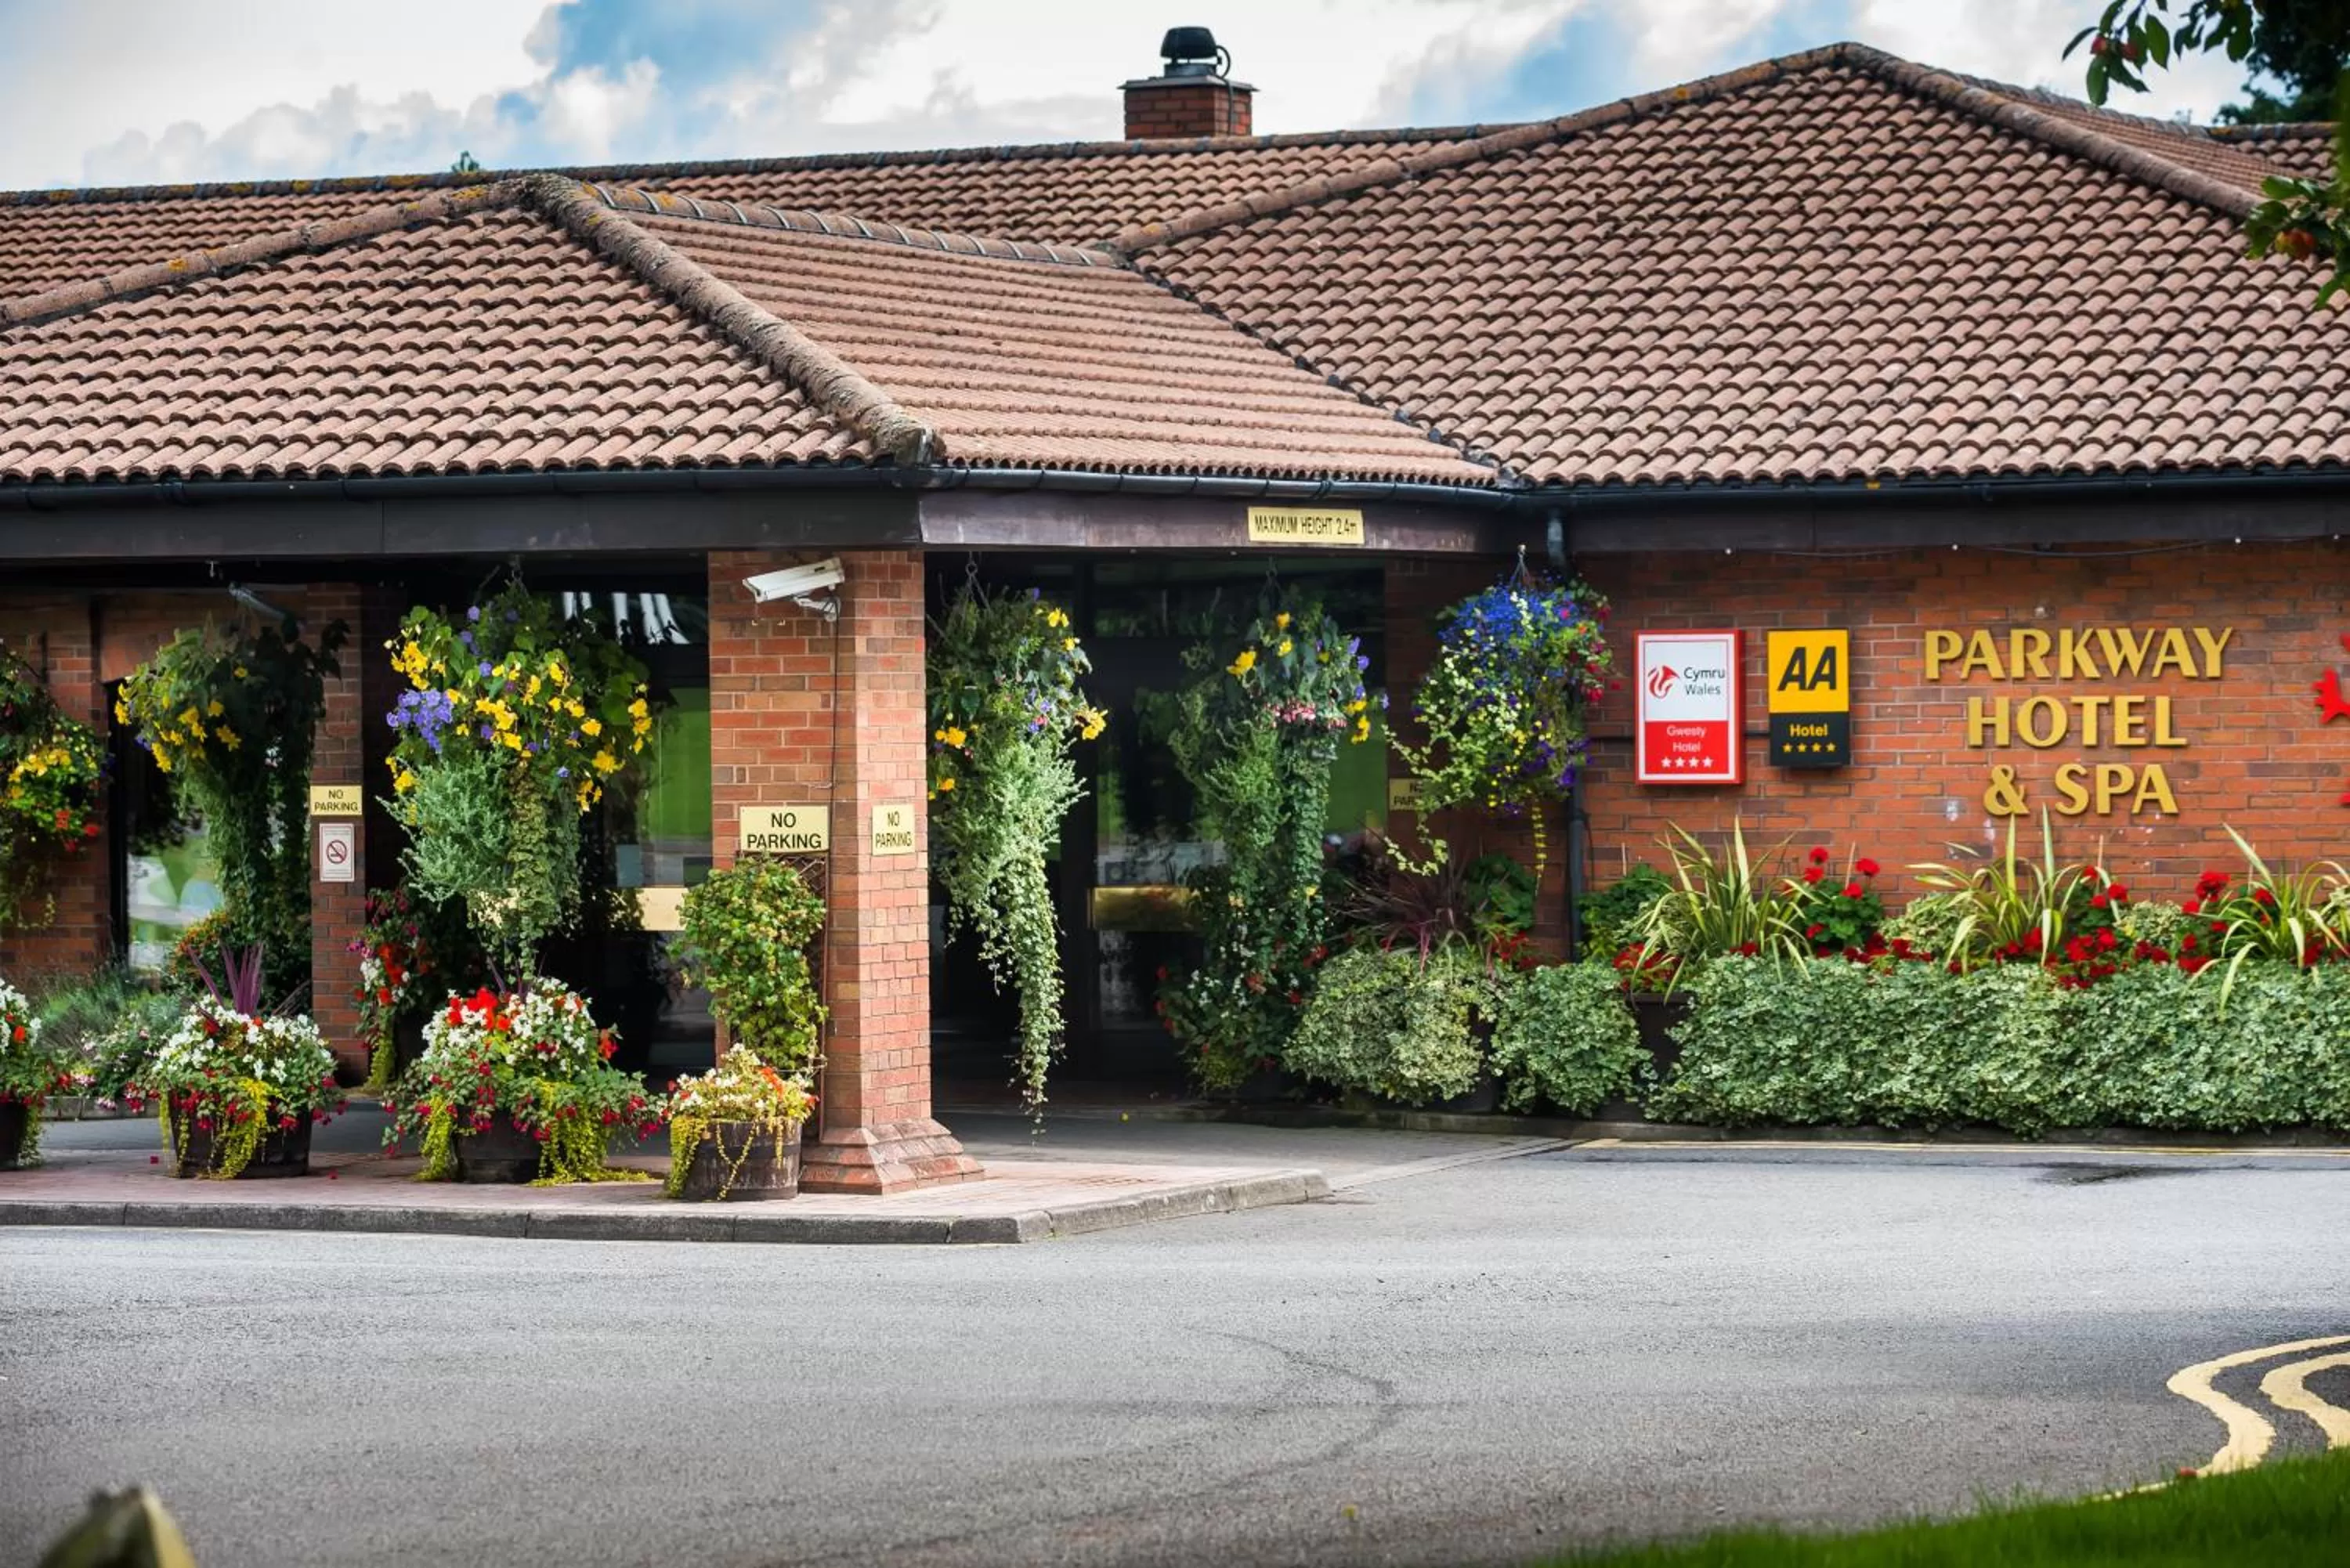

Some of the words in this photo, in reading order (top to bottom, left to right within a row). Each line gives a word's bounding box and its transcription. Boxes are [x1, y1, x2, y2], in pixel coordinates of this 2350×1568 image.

[1254, 515, 1297, 534] MAXIMUM
[1300, 516, 1332, 536] HEIGHT
[1336, 518, 1358, 537] 2.4m
[1925, 627, 2233, 680] PARKWAY
[1683, 667, 1725, 681] Cymru
[1777, 646, 1837, 692] AA
[1685, 684, 1721, 696] Wales
[1967, 695, 2189, 748] HOTEL
[1666, 725, 1706, 739] Gwesty
[1789, 724, 1828, 737] Hotel
[1672, 741, 1701, 752] Hotel
[328, 789, 344, 799] NO
[1983, 764, 2030, 816] &
[2055, 763, 2178, 816] SPA
[314, 801, 358, 812] PARKING
[771, 812, 797, 828] NO
[887, 811, 900, 827] NO
[747, 833, 822, 850] PARKING
[875, 832, 913, 849] PARKING
